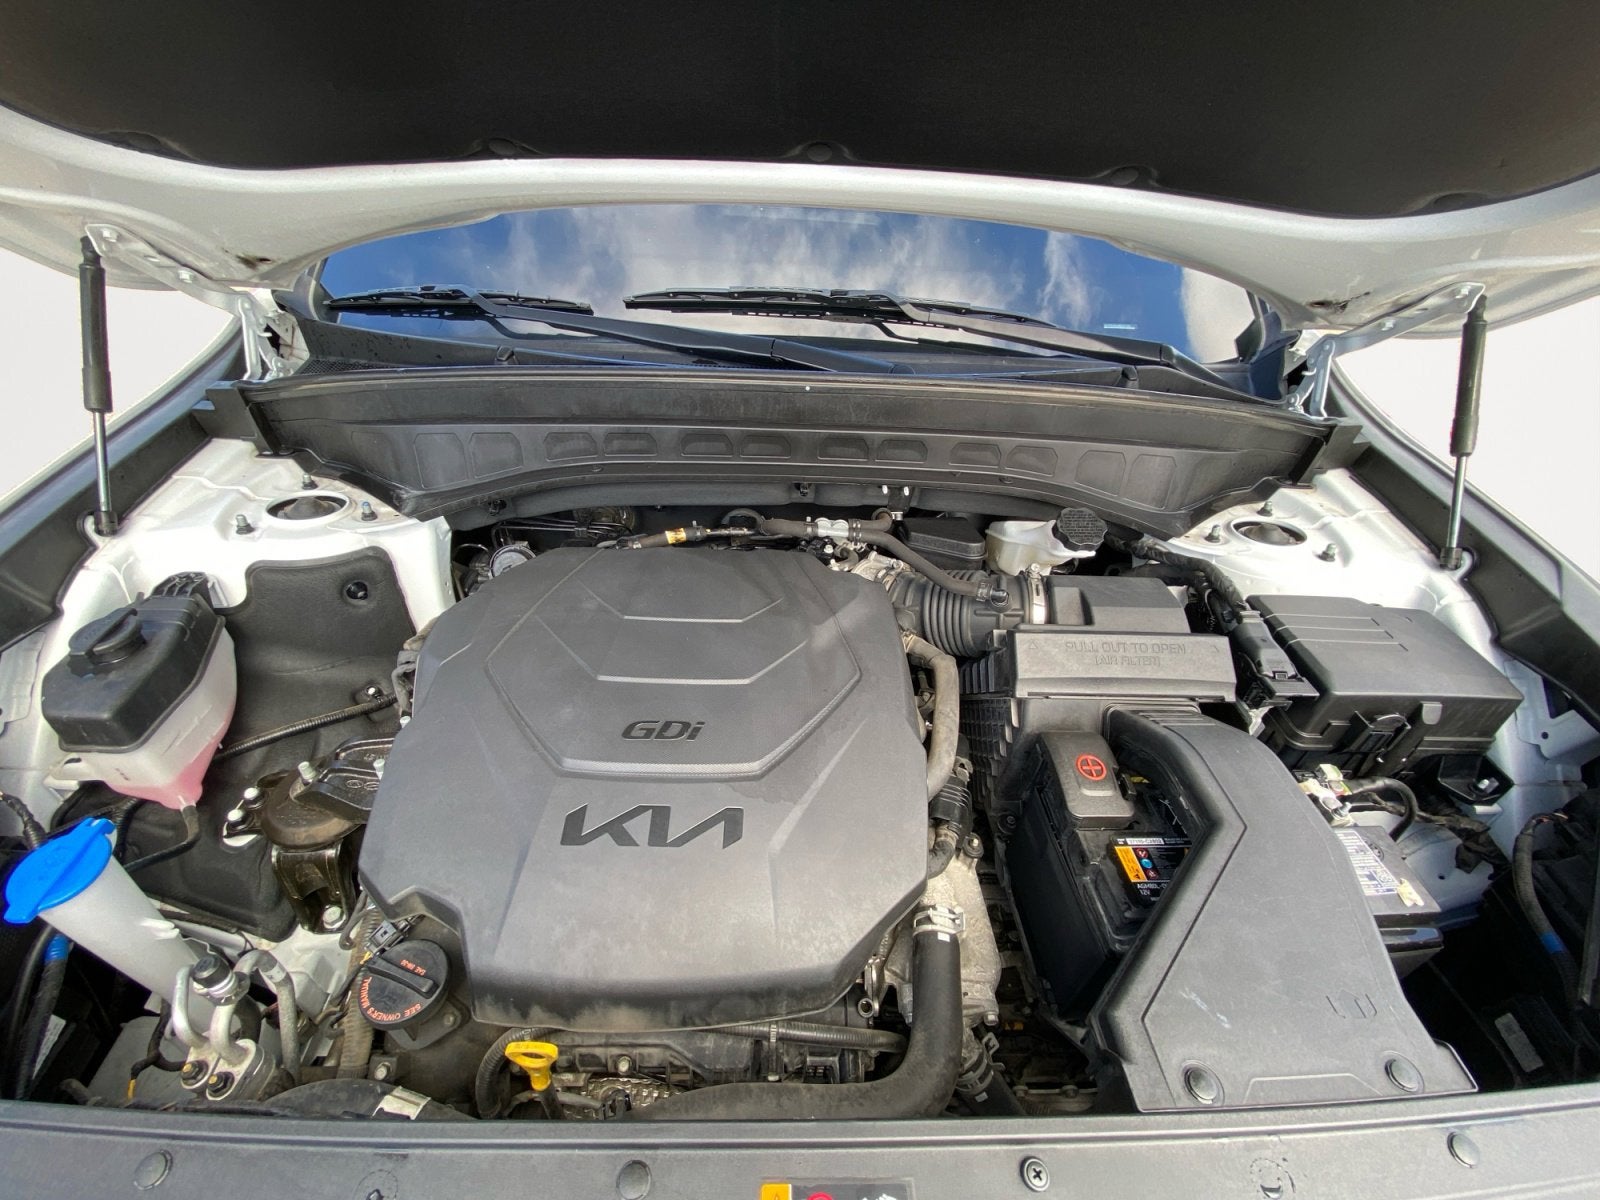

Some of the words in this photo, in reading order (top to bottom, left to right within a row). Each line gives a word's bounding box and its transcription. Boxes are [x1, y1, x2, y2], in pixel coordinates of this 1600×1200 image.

[1064, 640, 1099, 653] PULL
[1101, 641, 1127, 654] OUT
[1129, 642, 1149, 655] TO
[1151, 643, 1186, 655] OPEN
[621, 720, 706, 741] GDi
[560, 802, 744, 849] KIA
[414, 966, 427, 976] SAE
[360, 976, 373, 1009] MANUAL
[404, 1003, 421, 1017] SEE
